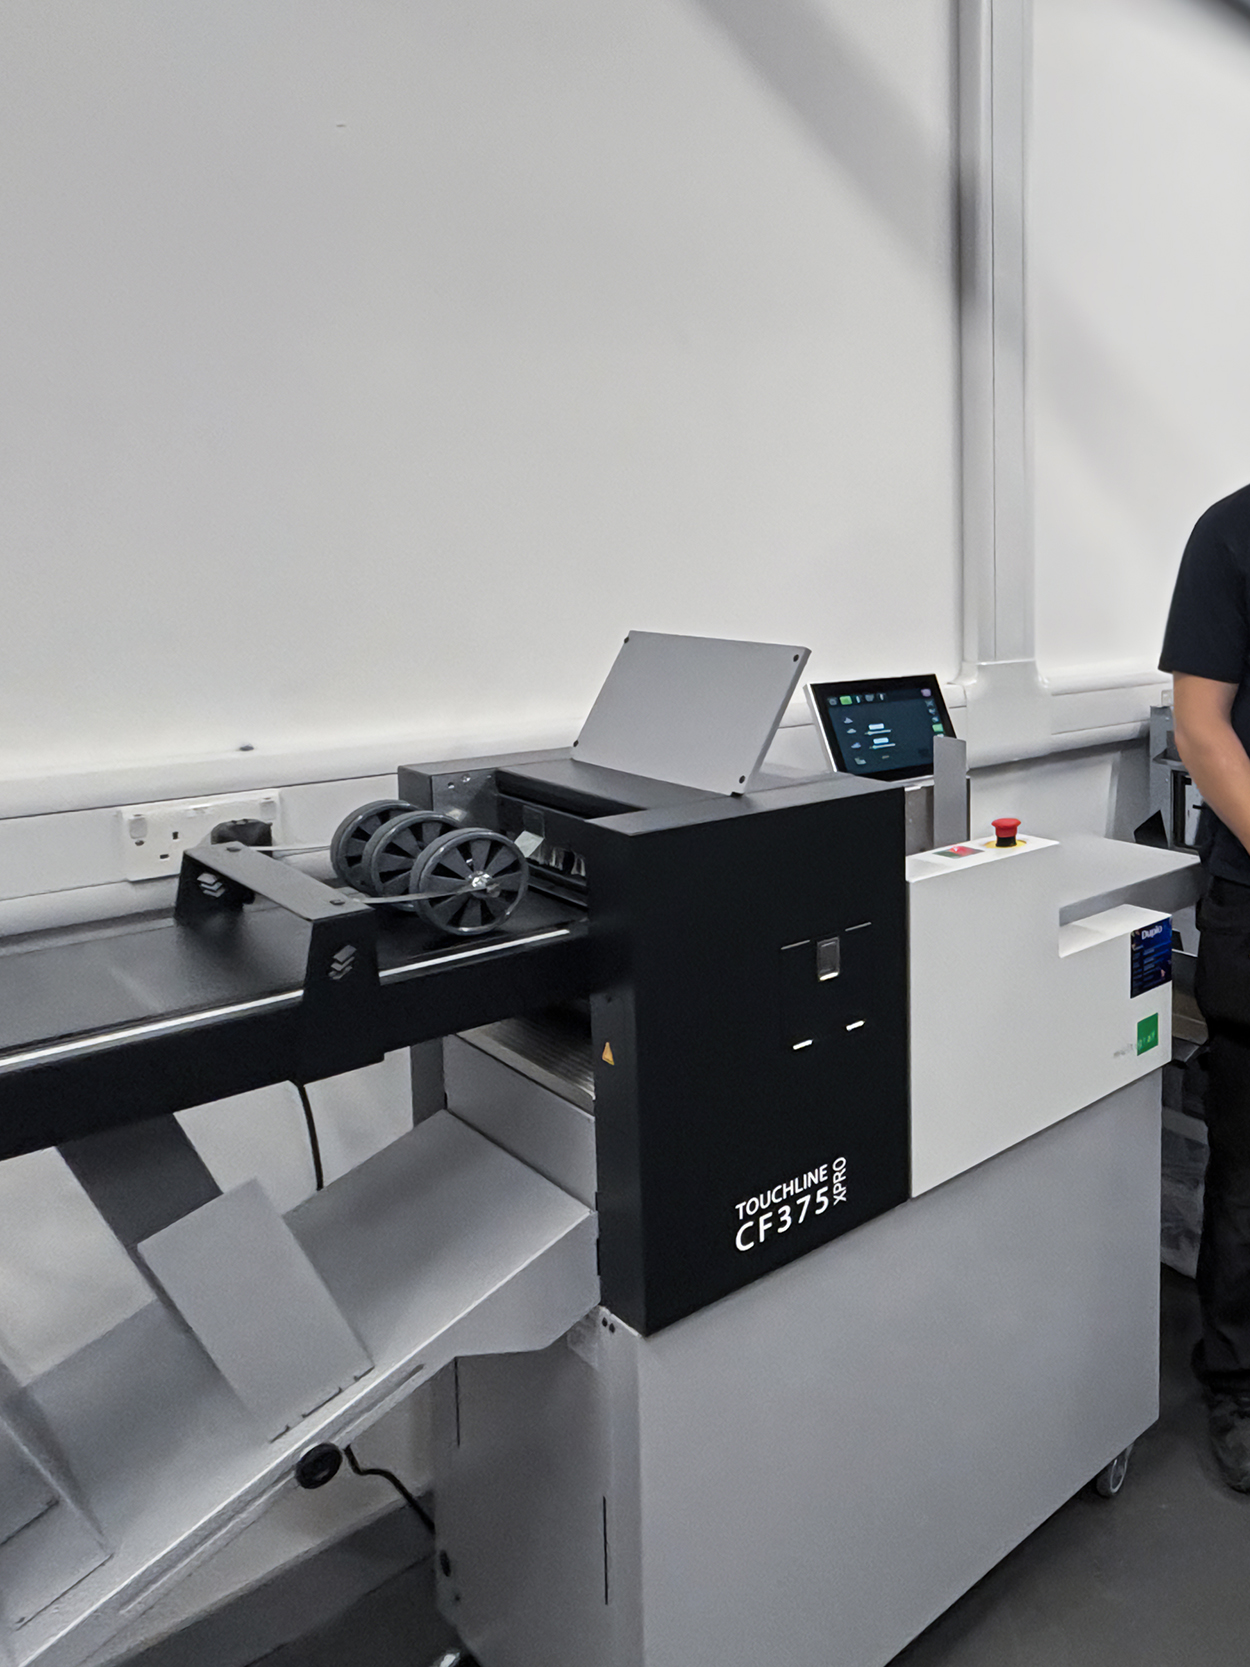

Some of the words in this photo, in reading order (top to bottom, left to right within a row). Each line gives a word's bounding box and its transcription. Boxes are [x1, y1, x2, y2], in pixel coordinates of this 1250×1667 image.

[735, 1163, 829, 1220] TOUCHLINE
[832, 1157, 847, 1206] XPRO
[735, 1186, 829, 1252] CF375
